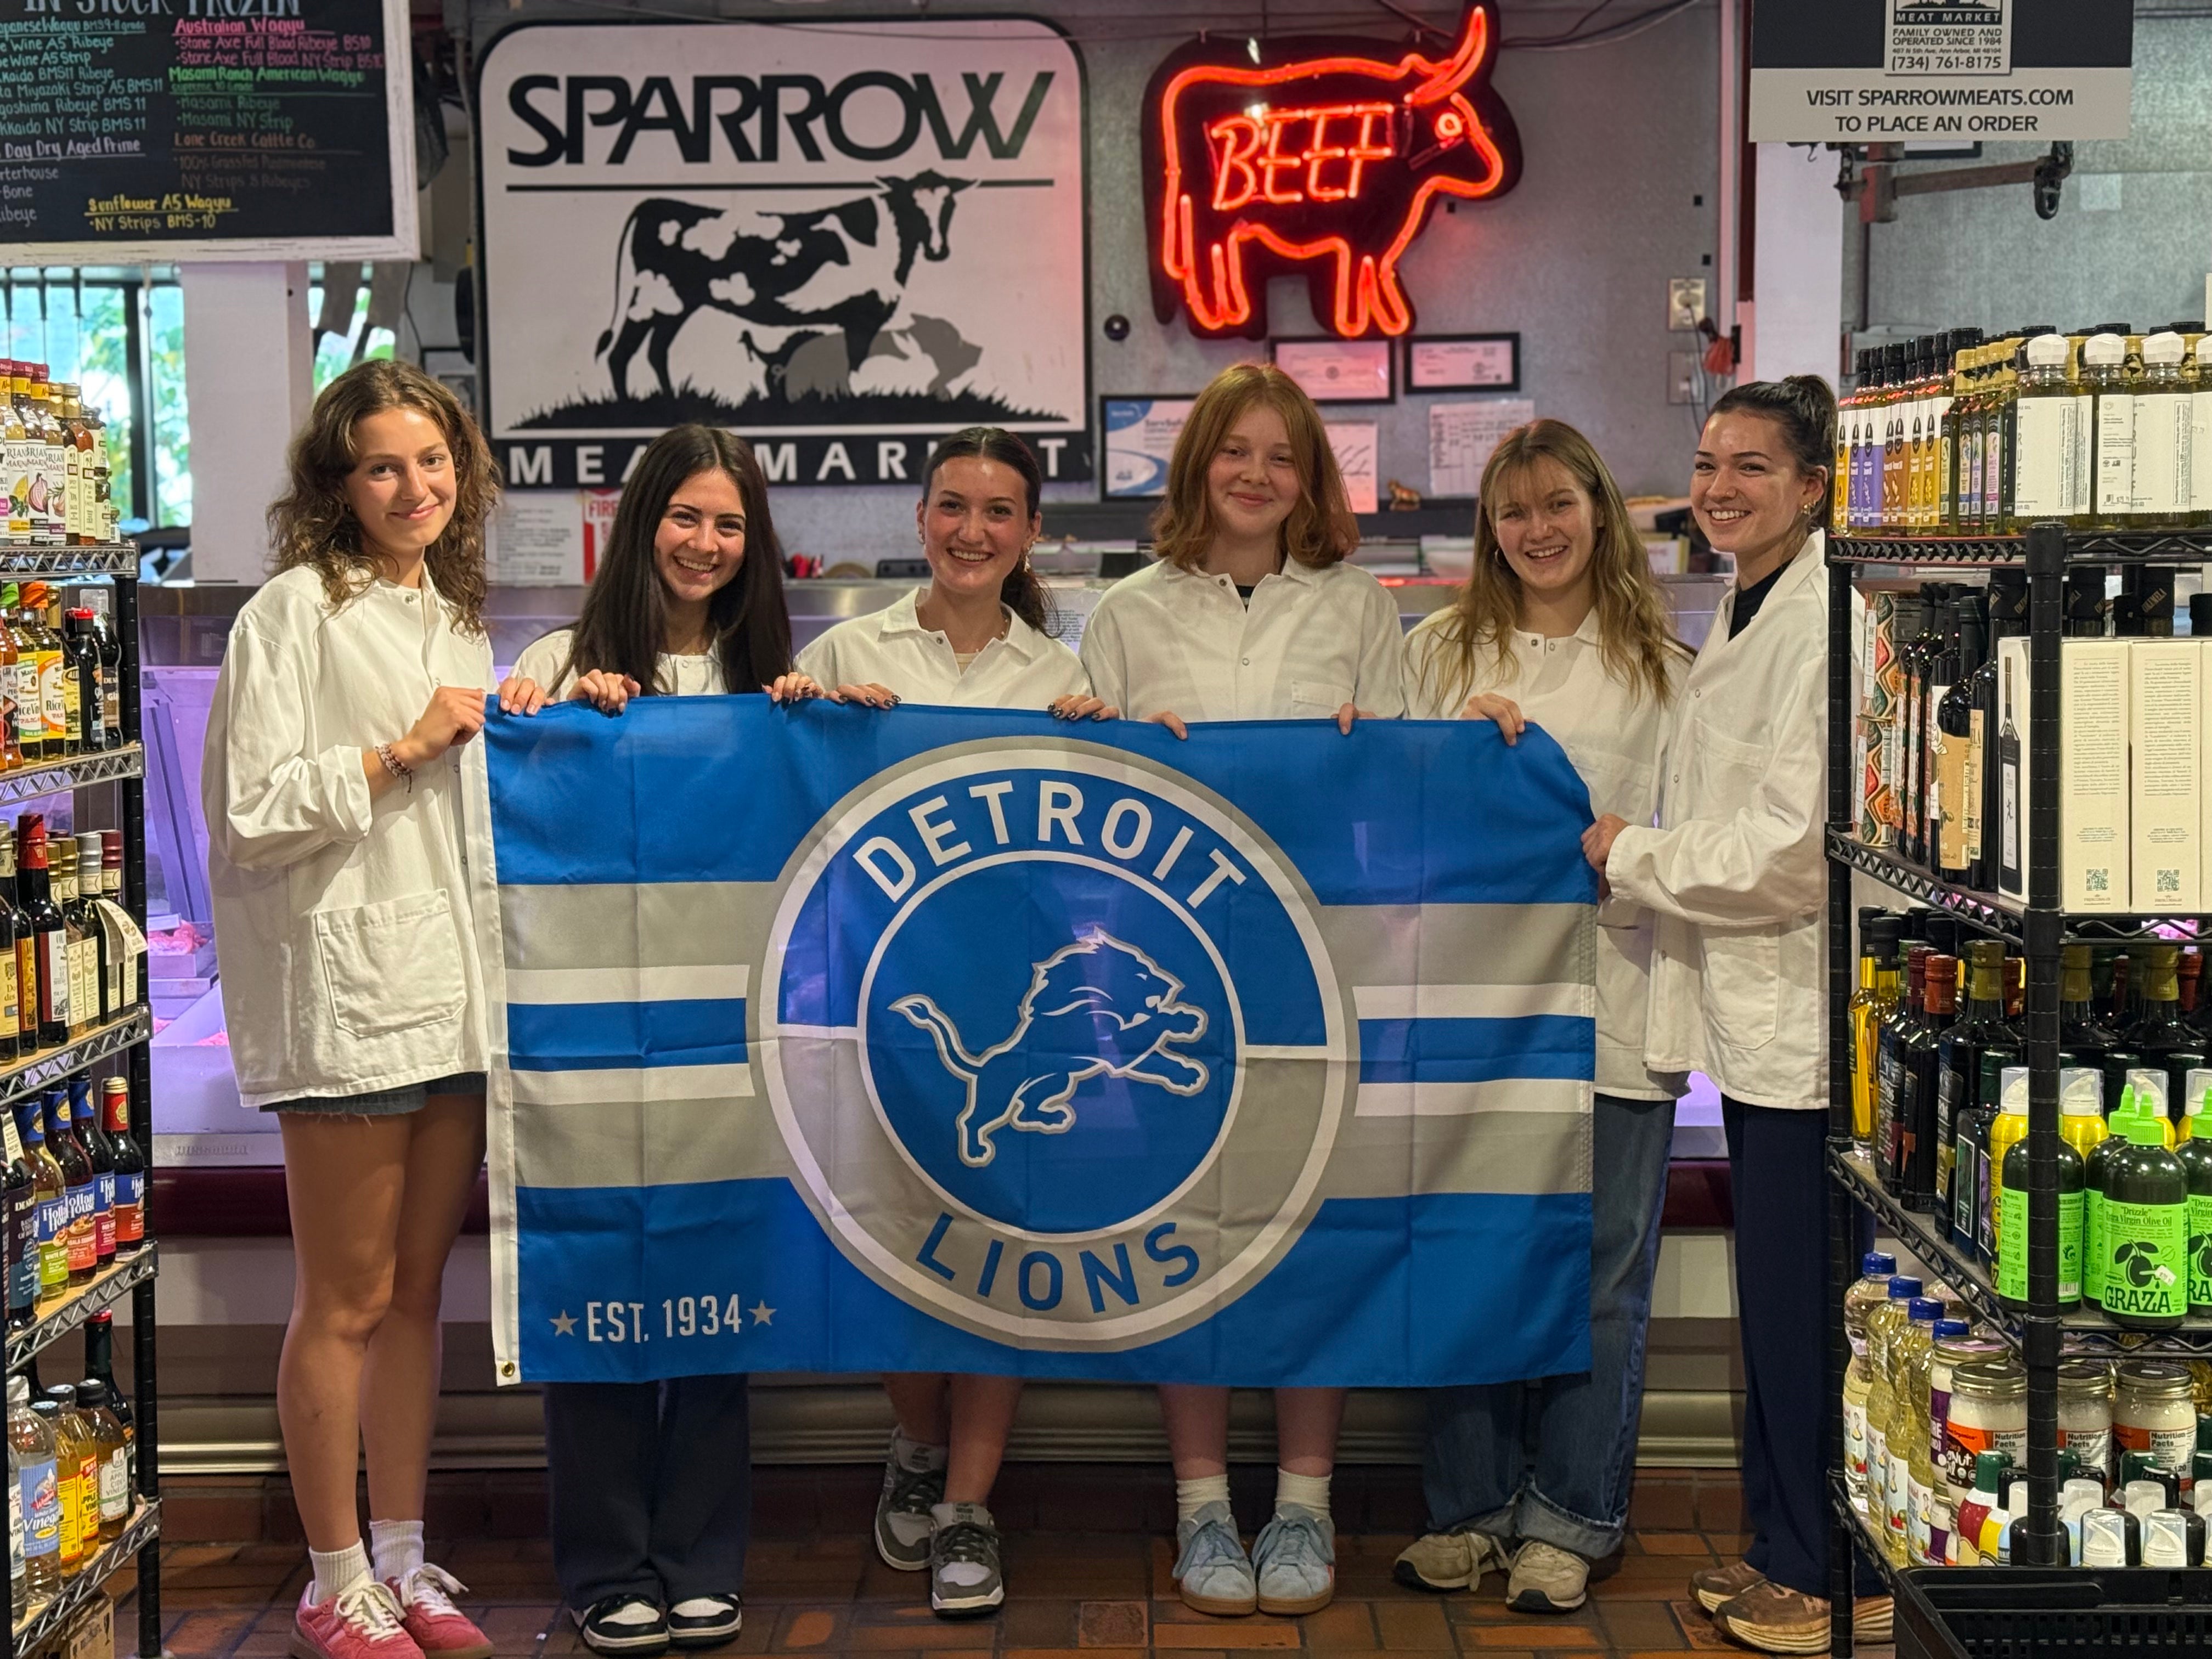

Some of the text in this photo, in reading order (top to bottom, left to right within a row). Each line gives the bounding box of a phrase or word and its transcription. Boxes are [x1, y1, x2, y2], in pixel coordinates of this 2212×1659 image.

[175, 16, 305, 36] Australian Wagyu
[1896, 13, 2000, 22] MEAT MARKET
[1933, 28, 1974, 36] OWNED
[1978, 28, 2002, 36] AND
[10, 38, 42, 51] Wine
[46, 37, 66, 50] A5
[72, 36, 114, 54] Ribeye
[180, 37, 211, 49] Stone
[215, 36, 241, 49] Axe
[245, 36, 264, 49] Full
[268, 36, 295, 50] Blood
[297, 36, 338, 54] Ribeye
[10, 55, 38, 67] Wine
[41, 52, 59, 65] A5
[60, 52, 91, 67] Strip
[180, 53, 210, 65] Stone
[213, 53, 238, 65] Axe
[242, 52, 263, 65] Full
[267, 52, 299, 65] Blood
[302, 53, 320, 68] NY
[324, 54, 353, 72] Strip
[1892, 56, 2001, 71] (734) 761-8175
[78, 67, 114, 83] Ribeye
[168, 67, 364, 88] Masami Ranch American Wagyu
[17, 83, 70, 101] Miyazaki
[74, 82, 104, 100] Strip
[109, 79, 125, 94] A5
[1807, 89, 2074, 106] VISIT SPARROWMEATS.COM
[55, 98, 98, 117] Ribeye
[103, 97, 132, 111] BMS
[134, 97, 145, 110] 11
[238, 96, 280, 114] Ribeye
[46, 117, 64, 134] NY
[69, 118, 99, 137] Strip
[101, 117, 132, 133] BMS
[134, 117, 145, 130] 11
[236, 113, 256, 128] NY
[259, 113, 293, 133] Strip
[507, 71, 1056, 166] SPARROW
[1835, 116, 2038, 132] TO PLACE AN ORDER
[210, 131, 246, 146] Creek
[5, 137, 140, 161] Day Dry Aged Prime
[1211, 104, 1393, 210] BEEF
[88, 194, 232, 214] Sunflower A5 Wagyu
[95, 214, 216, 234] NY Strips BMS-10
[755, 439, 1067, 483] MART
[854, 779, 1248, 910] DETROIT
[2120, 1215, 2141, 1225] Virgin
[2143, 1217, 2161, 1225] Olive
[2163, 1216, 2172, 1226] Oil
[917, 1211, 1203, 1314] LIONS
[2106, 1285, 2171, 1313] GRAZA
[586, 1293, 743, 1344] EST. 1934
[1995, 1432, 2025, 1440] Nutrition
